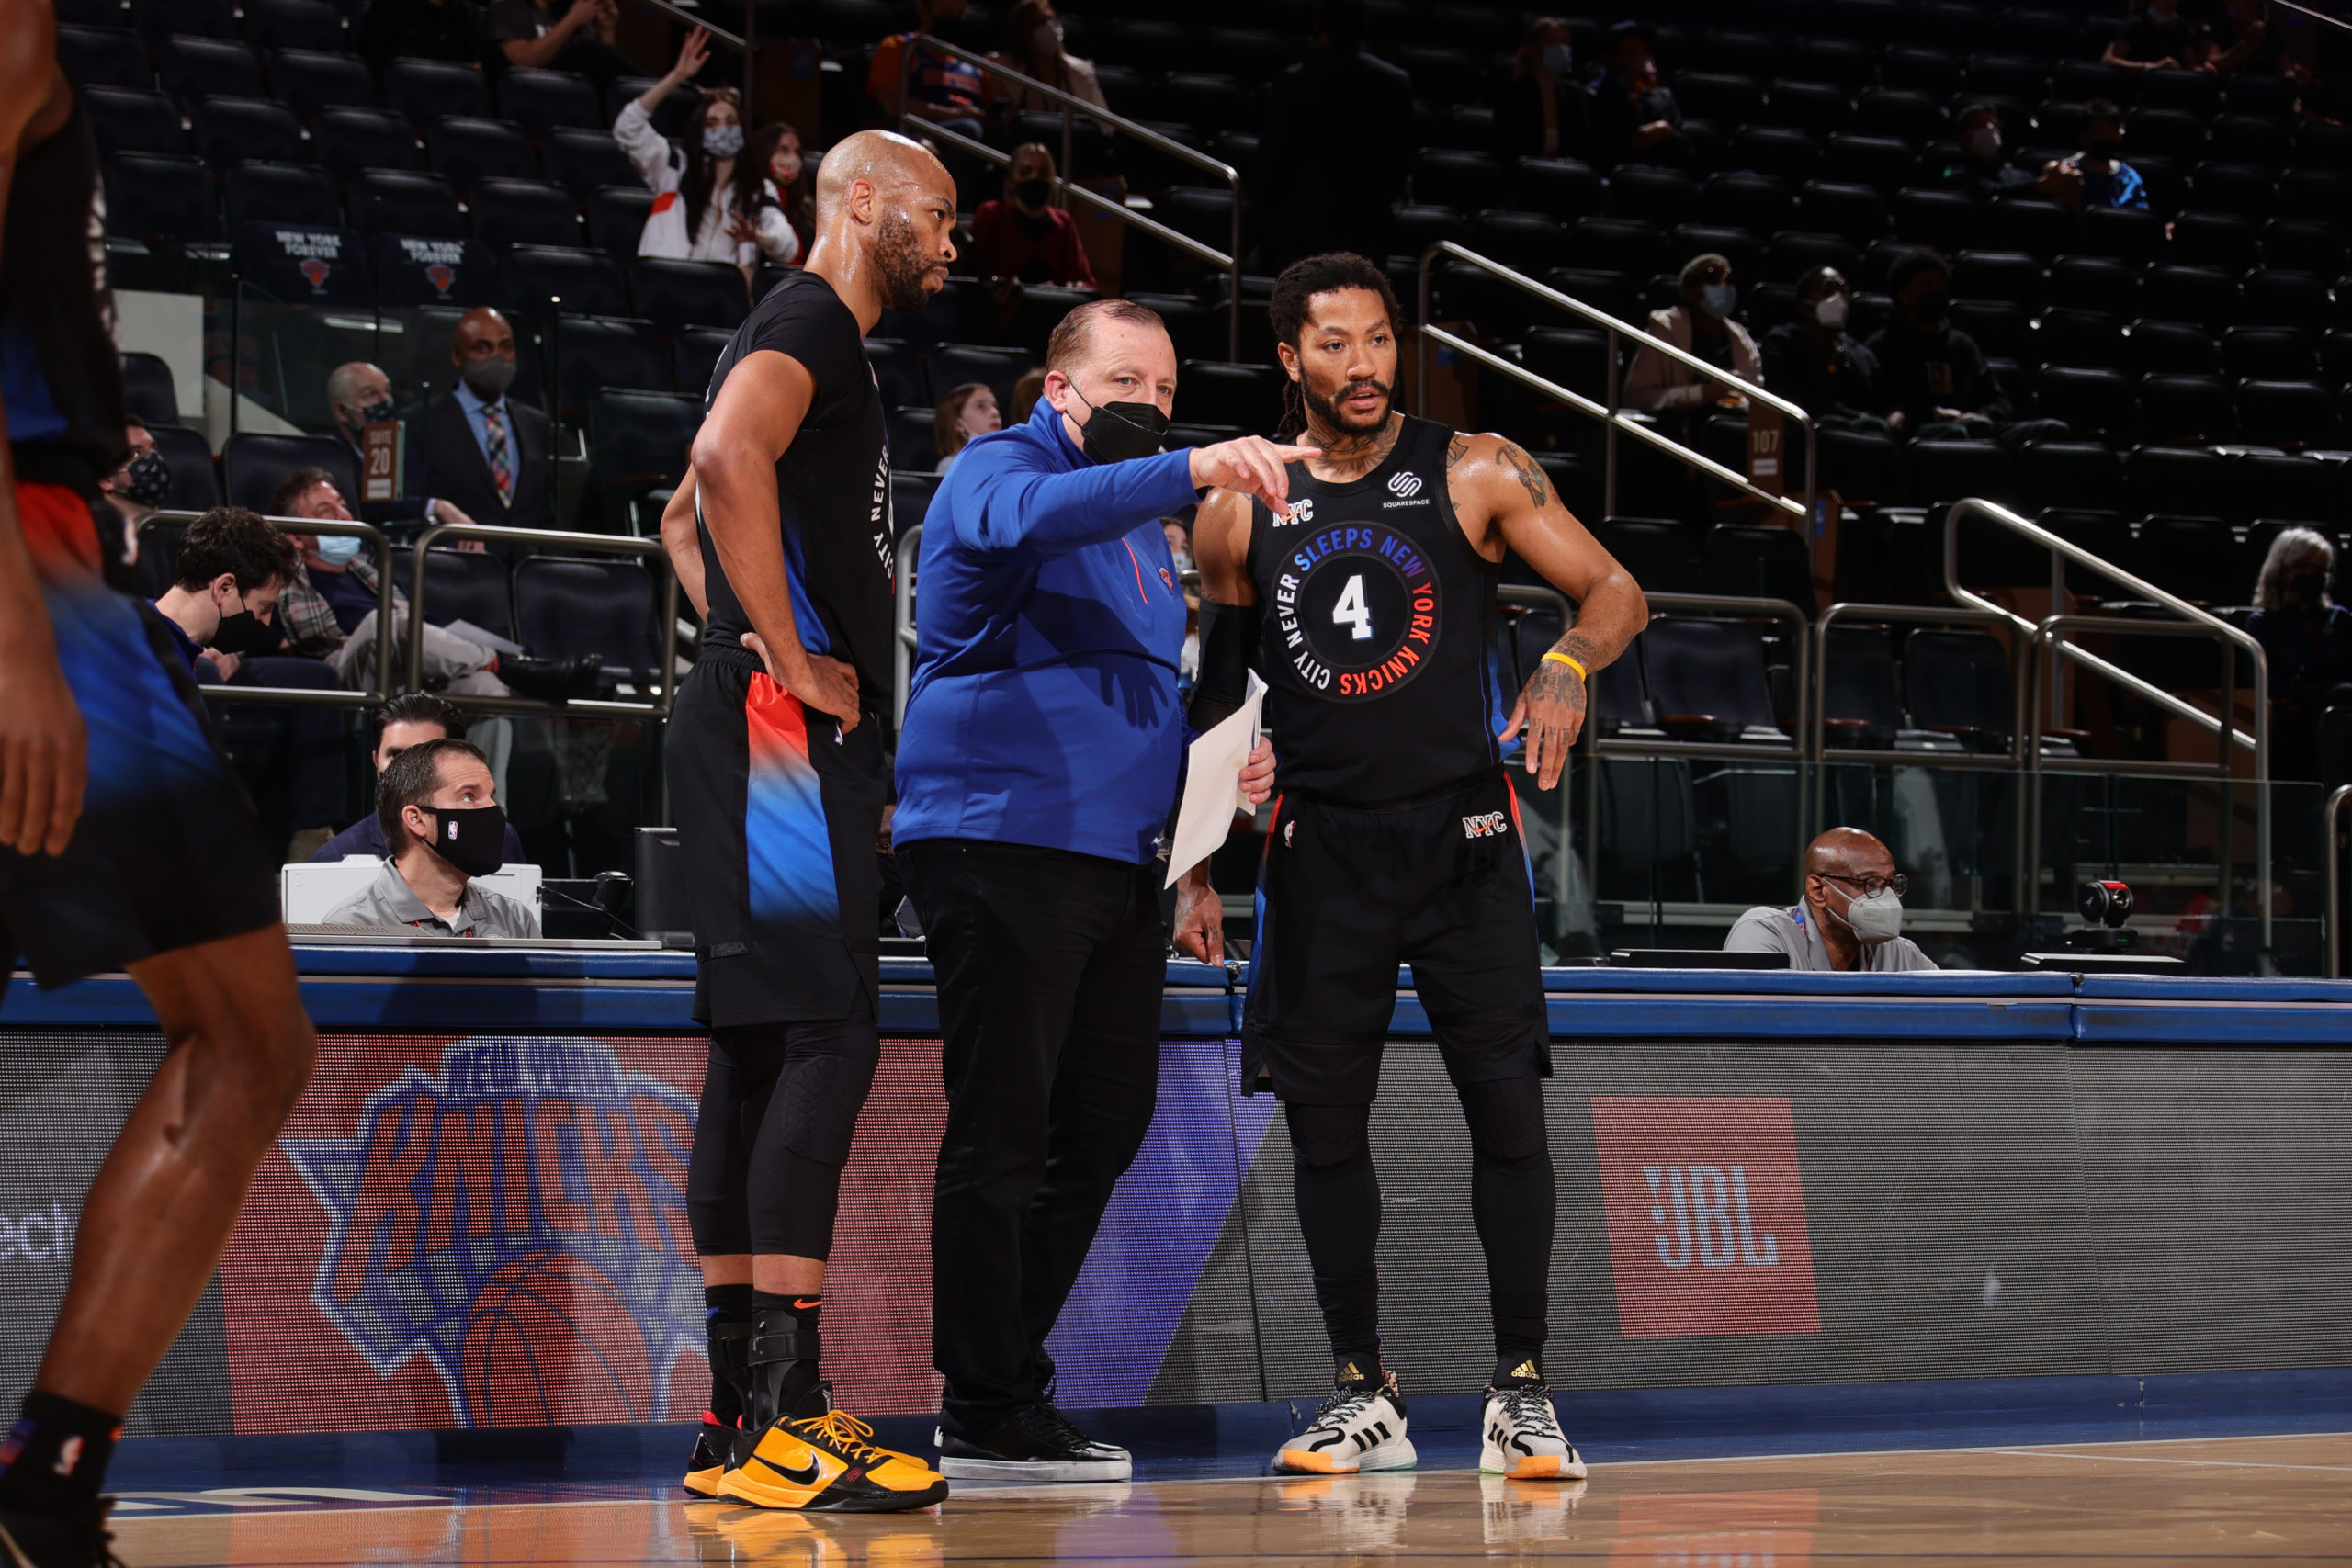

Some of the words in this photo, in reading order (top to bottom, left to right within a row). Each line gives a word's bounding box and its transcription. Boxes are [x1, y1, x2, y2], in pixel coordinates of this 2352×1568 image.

[276, 231, 304, 244] NEW
[306, 232, 342, 247] YORK
[285, 243, 338, 258] FOREVER
[400, 238, 428, 251] NEW
[411, 249, 462, 264] FOREVER
[369, 430, 392, 445] SUITE
[1753, 430, 1780, 453] 107
[370, 447, 390, 475] 20
[871, 445, 889, 522] NEVER
[1383, 499, 1430, 509] SQUARESPACE
[1294, 528, 1373, 571] SLEEPS
[1379, 536, 1426, 578] NEW
[1277, 573, 1303, 649] NEVER
[1332, 573, 1374, 640] 4
[1409, 582, 1434, 645] YORK
[1294, 650, 1331, 690] CITY
[1340, 645, 1420, 695] KNICKS
[1462, 811, 1508, 839] NYC
[447, 1042, 519, 1100] NEW
[332, 1092, 704, 1303] KNICKS
[1643, 1165, 1779, 1268] JBL
